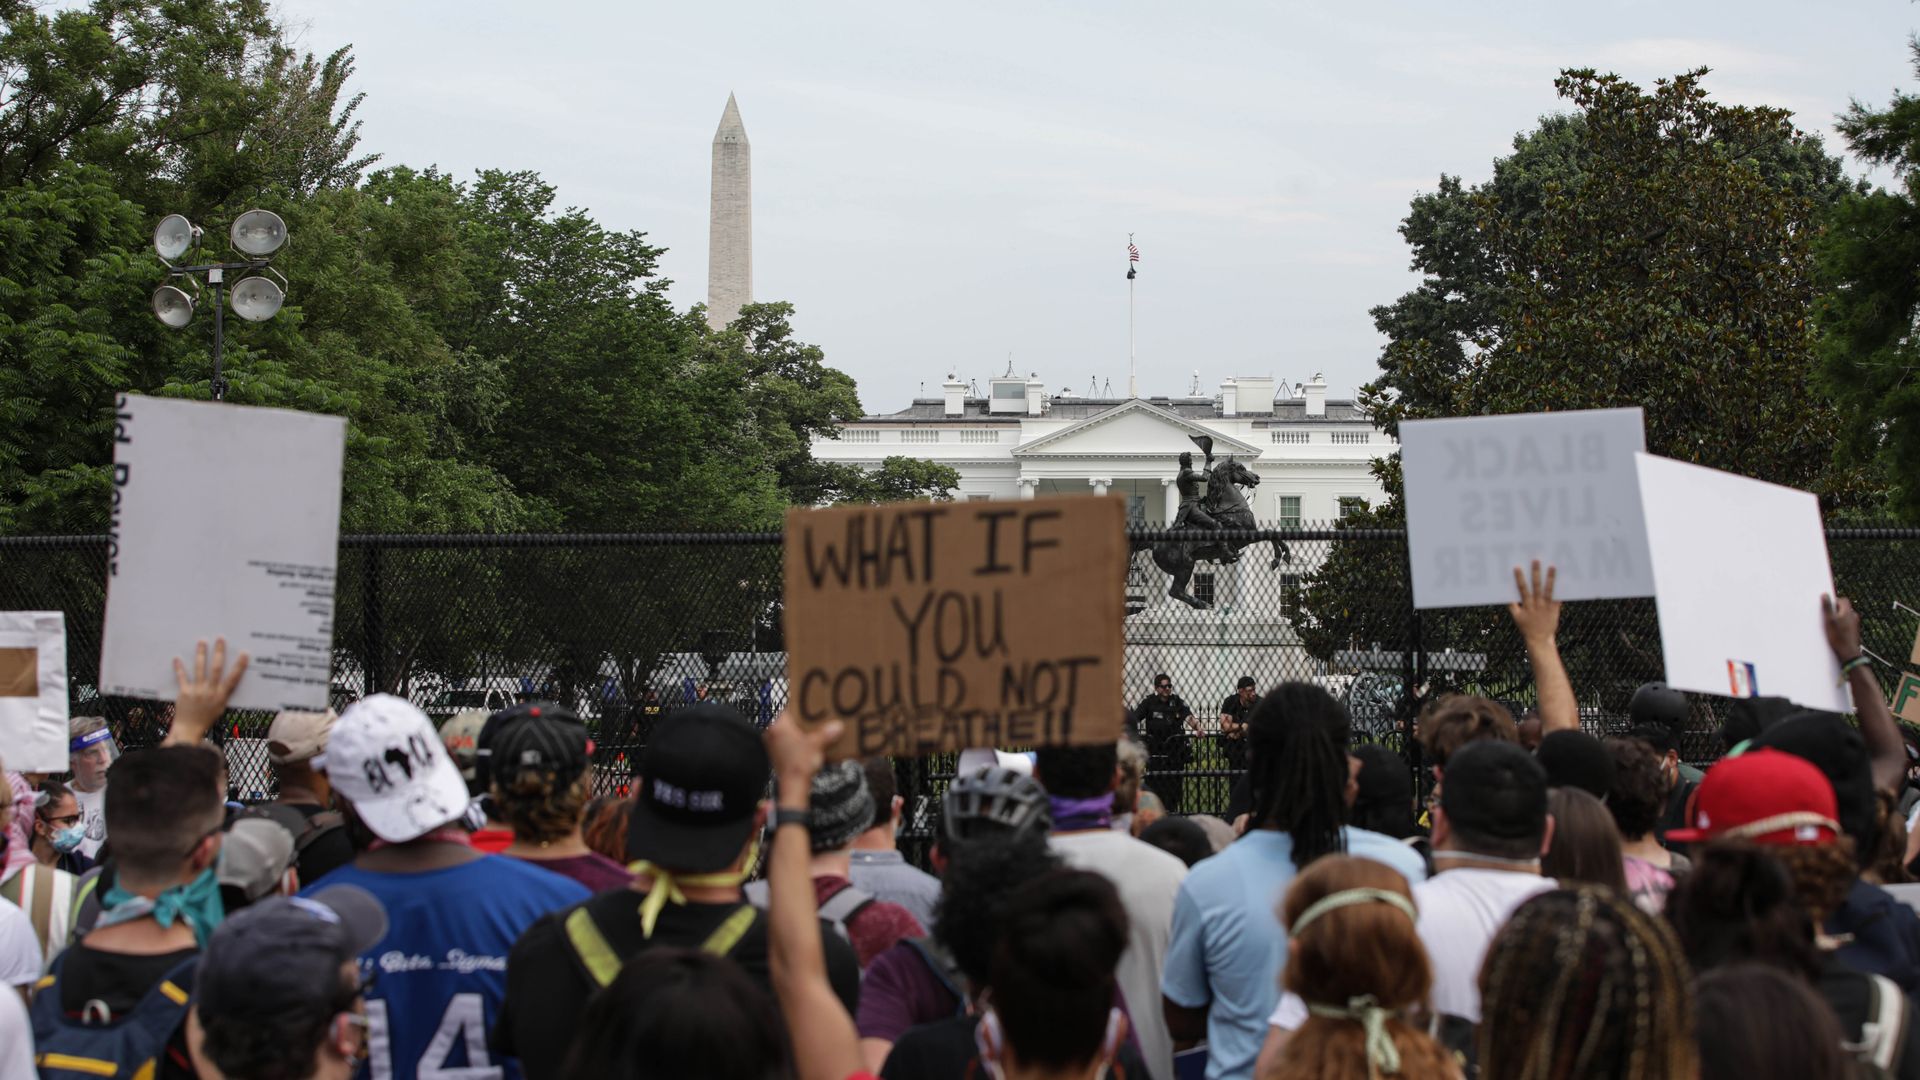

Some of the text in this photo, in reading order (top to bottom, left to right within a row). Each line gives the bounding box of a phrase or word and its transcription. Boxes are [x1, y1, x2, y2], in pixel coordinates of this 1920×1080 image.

[803, 508, 1064, 590] WHAT IF
[891, 590, 1009, 664] YOU
[799, 657, 1101, 722] COULD NOT
[365, 992, 504, 1080] 14
